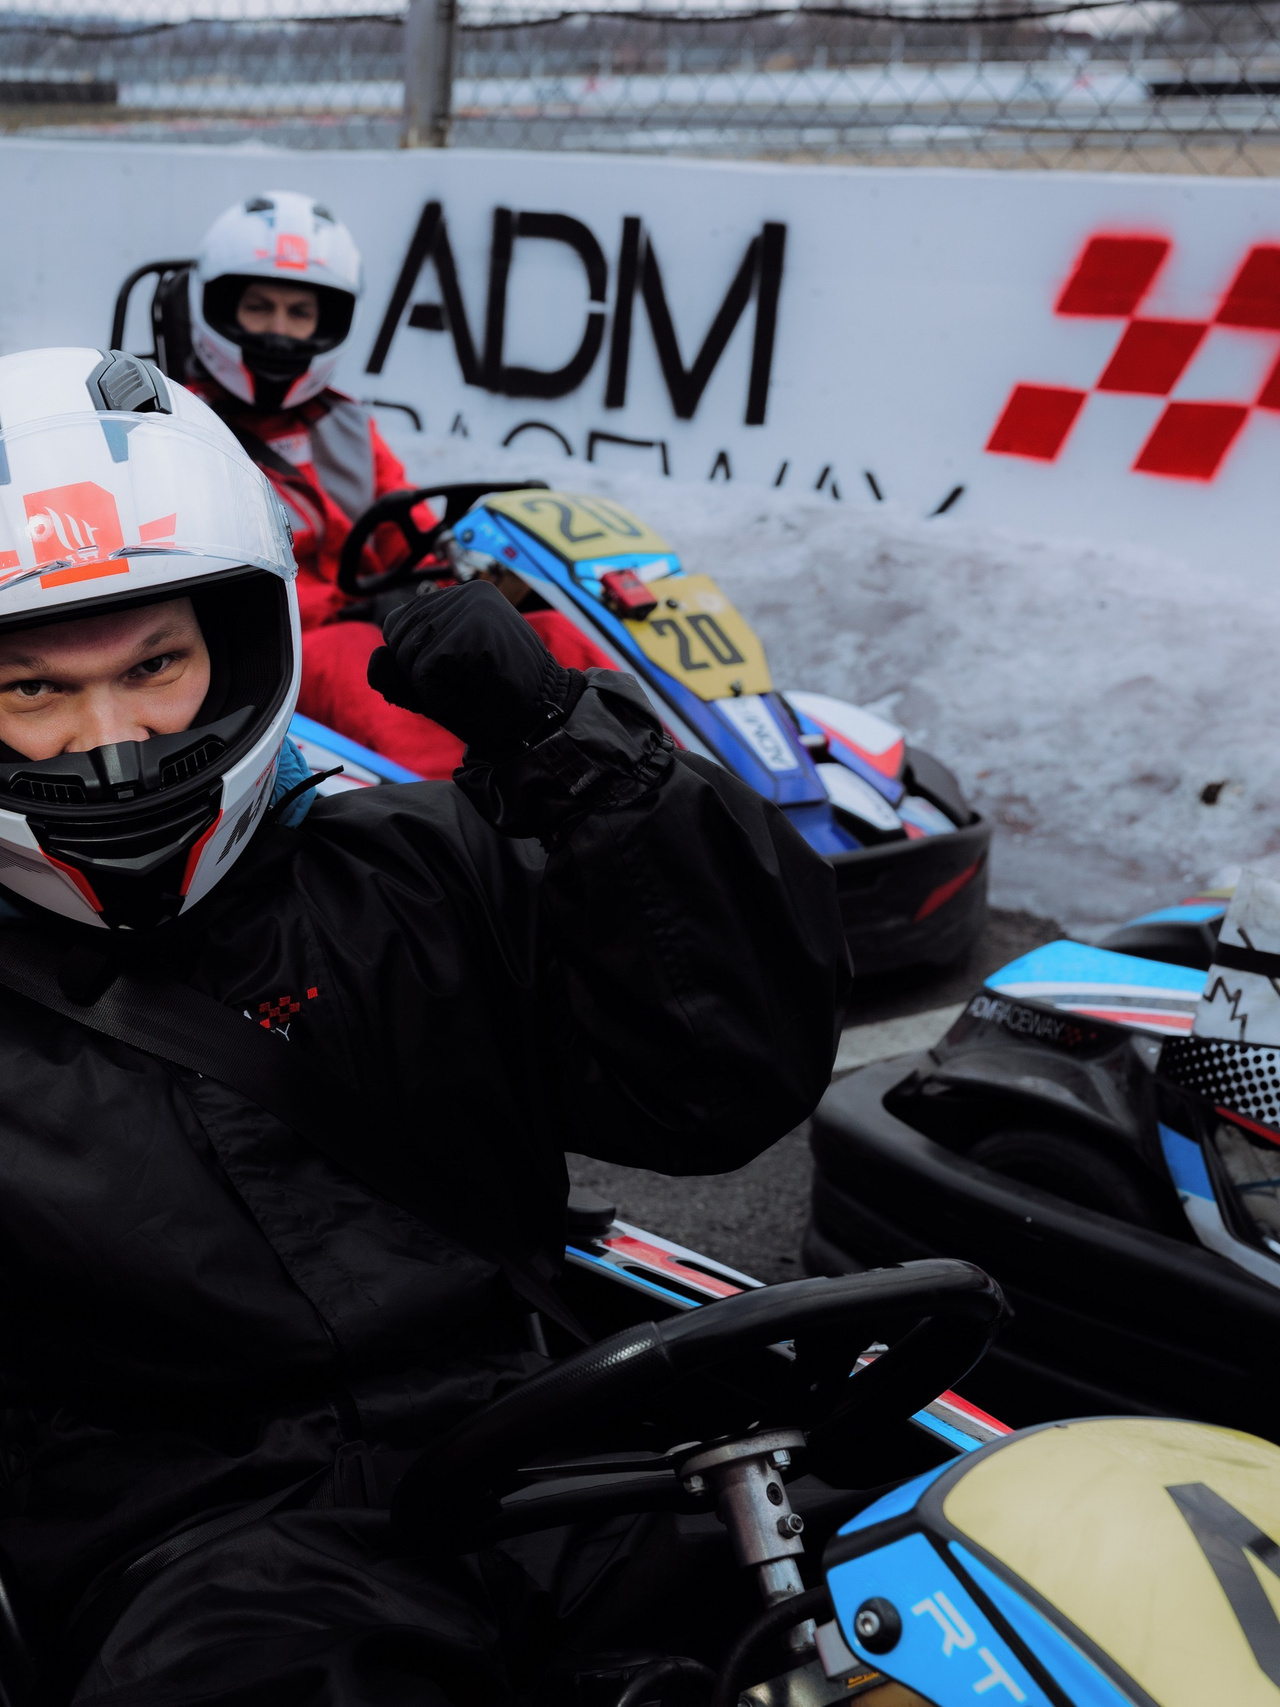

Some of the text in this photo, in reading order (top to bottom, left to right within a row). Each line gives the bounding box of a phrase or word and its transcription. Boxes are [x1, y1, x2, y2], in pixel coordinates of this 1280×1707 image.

[365, 200, 786, 425] ADM
[523, 495, 642, 543] 20
[651, 614, 744, 670] 20
